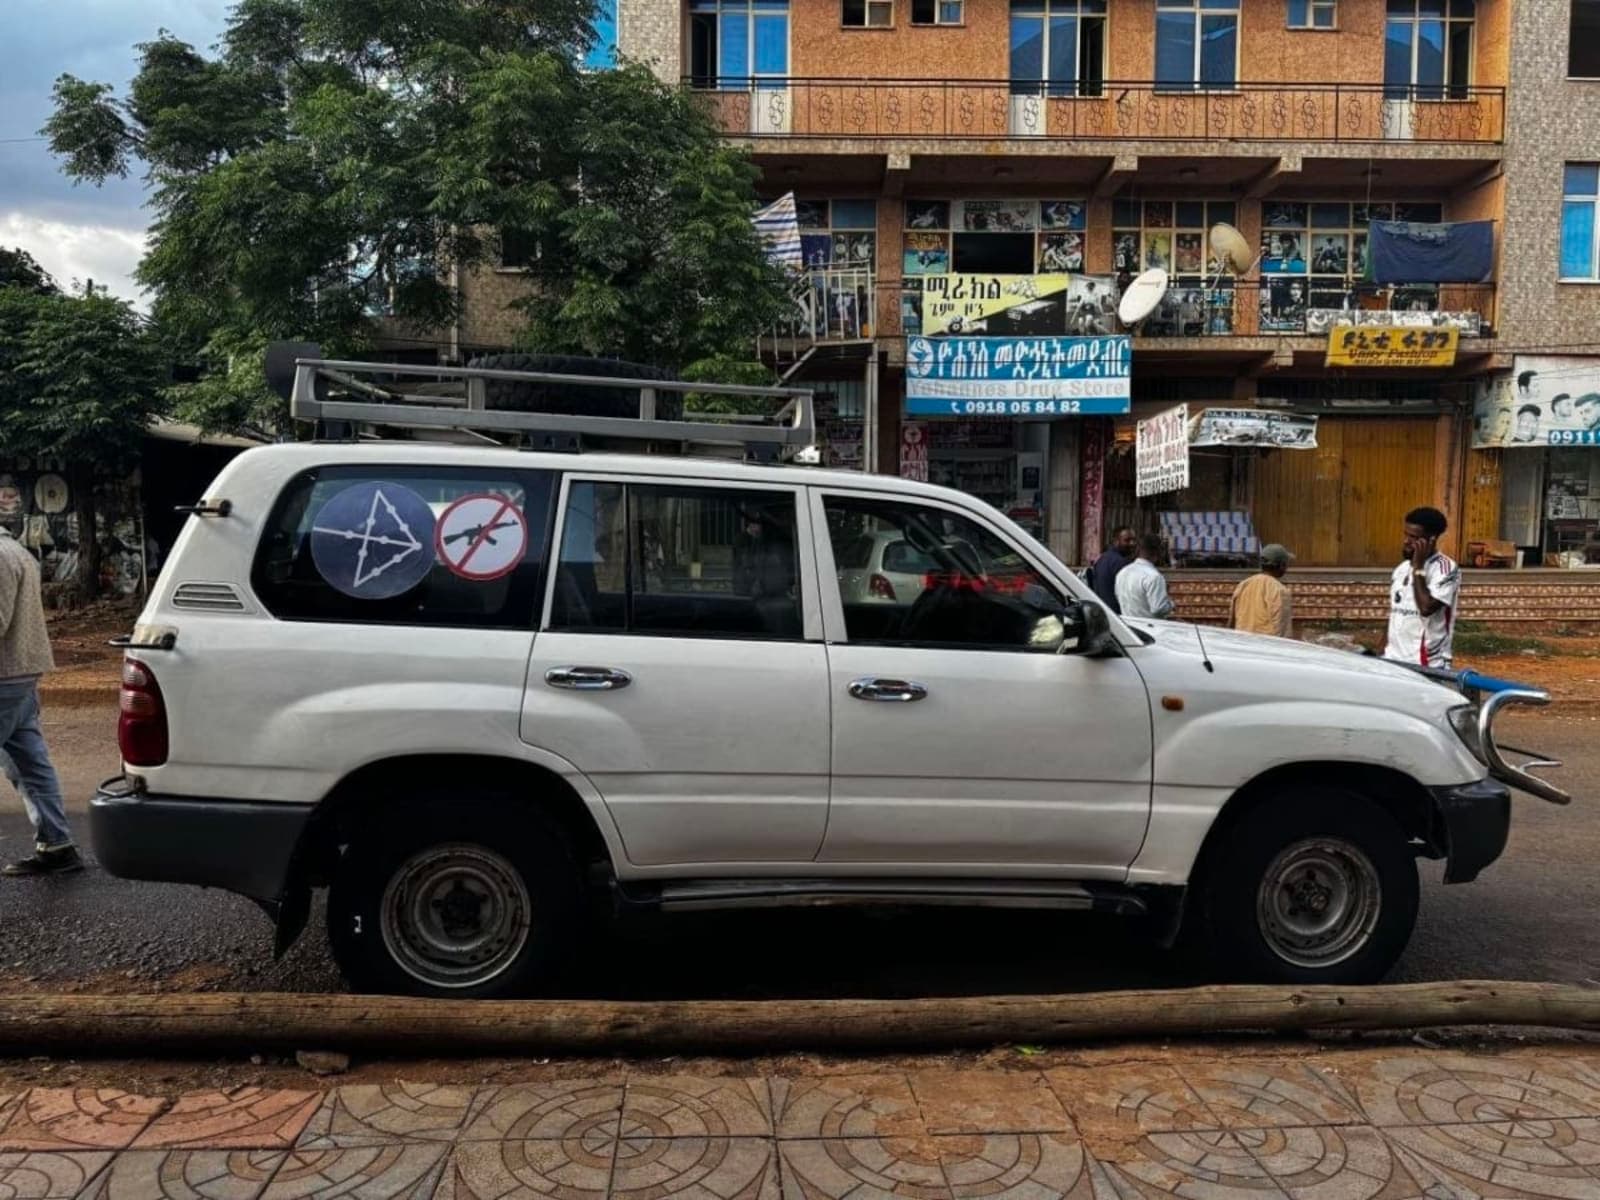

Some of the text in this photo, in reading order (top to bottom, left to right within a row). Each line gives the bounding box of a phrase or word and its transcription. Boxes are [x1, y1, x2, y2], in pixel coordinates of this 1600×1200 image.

[927, 276, 1002, 300] ሚራክል
[1348, 349, 1384, 359] Unity
[1015, 380, 1062, 399] Drug
[1071, 380, 1124, 396] Store
[966, 401, 1081, 414] 0918 05 84 82
[1550, 430, 1600, 445] 0911
